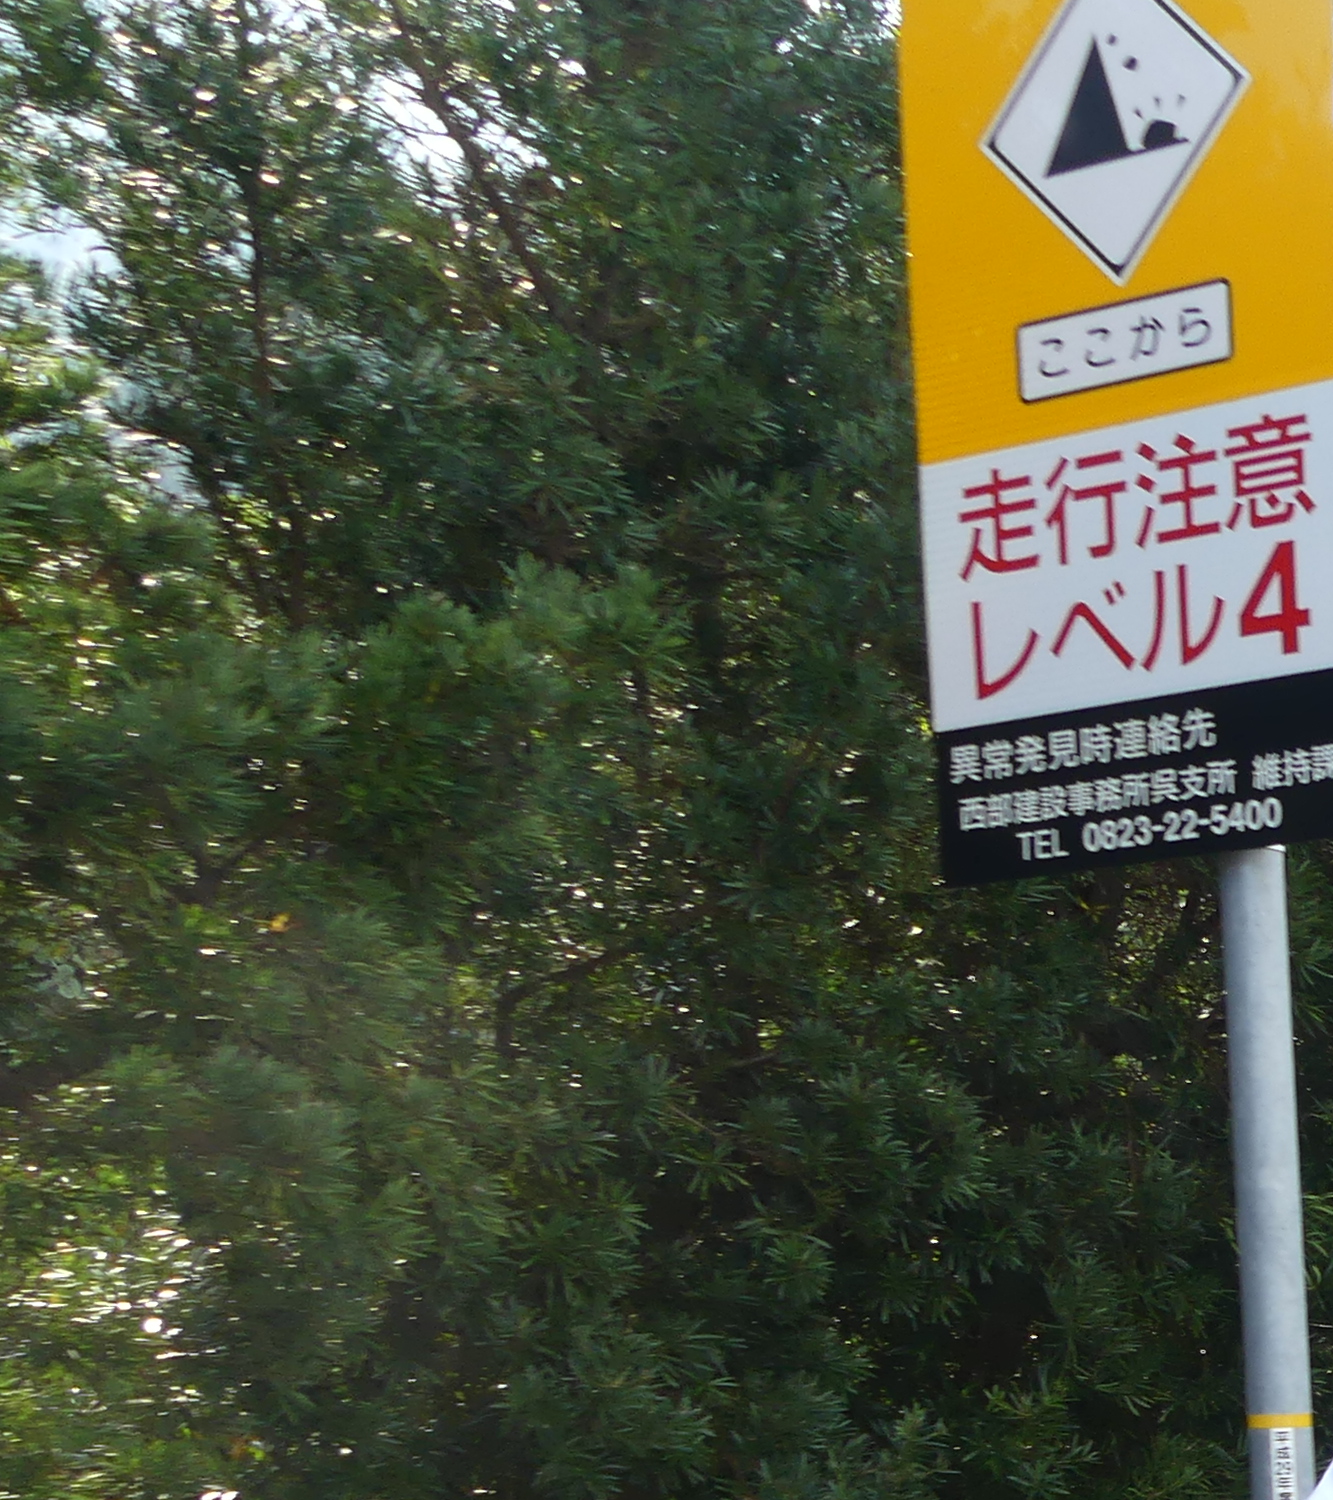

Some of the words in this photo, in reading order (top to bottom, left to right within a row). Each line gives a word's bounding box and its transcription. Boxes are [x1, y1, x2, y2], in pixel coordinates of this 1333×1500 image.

[1037, 307, 1213, 379] ここから
[957, 412, 1318, 582] 走行注意
[968, 539, 1312, 701] レベル4
[950, 707, 1218, 784] 異常発見時連絡先
[958, 759, 1238, 832] 西部建設事務所呉支所
[1015, 831, 1069, 862] TEL
[1082, 796, 1283, 852] 0823-22-5400
